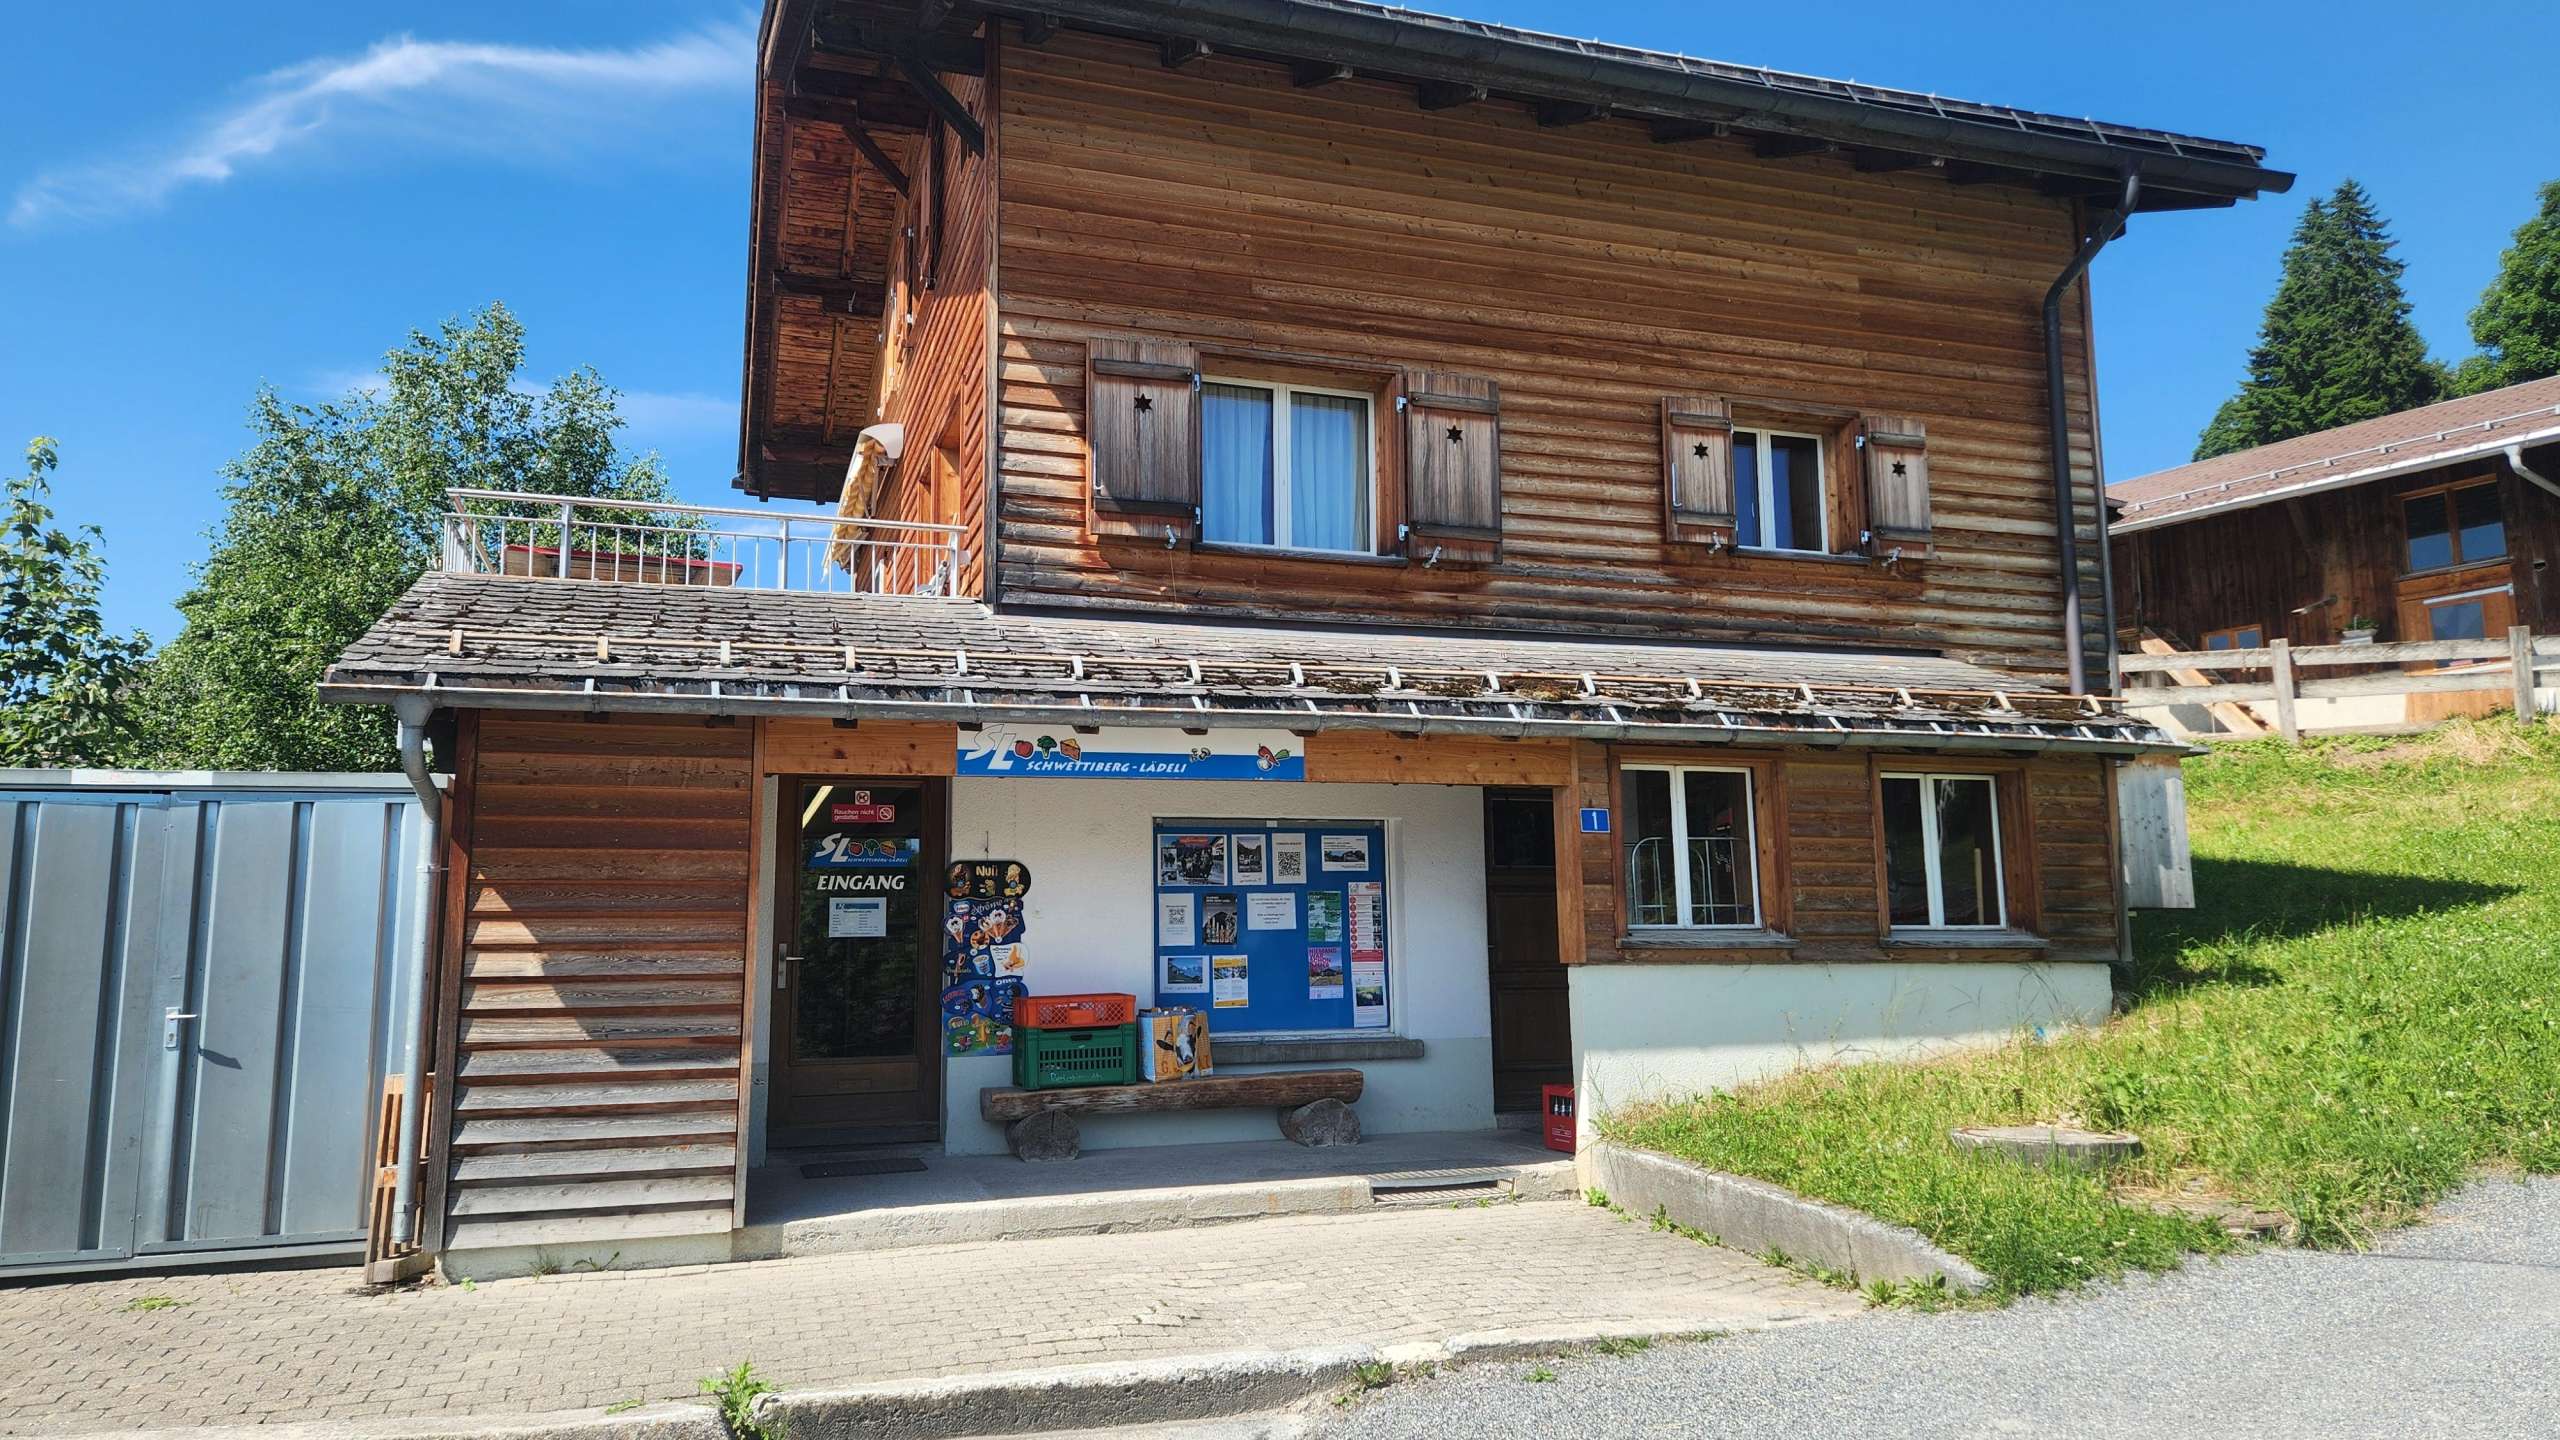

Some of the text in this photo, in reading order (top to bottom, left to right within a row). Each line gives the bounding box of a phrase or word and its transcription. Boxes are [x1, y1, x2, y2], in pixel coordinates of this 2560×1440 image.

[833, 808, 859, 816] Rauchen
[1592, 811, 1598, 830] 1
[814, 832, 851, 862] SL
[816, 875, 905, 890] EINGANG
